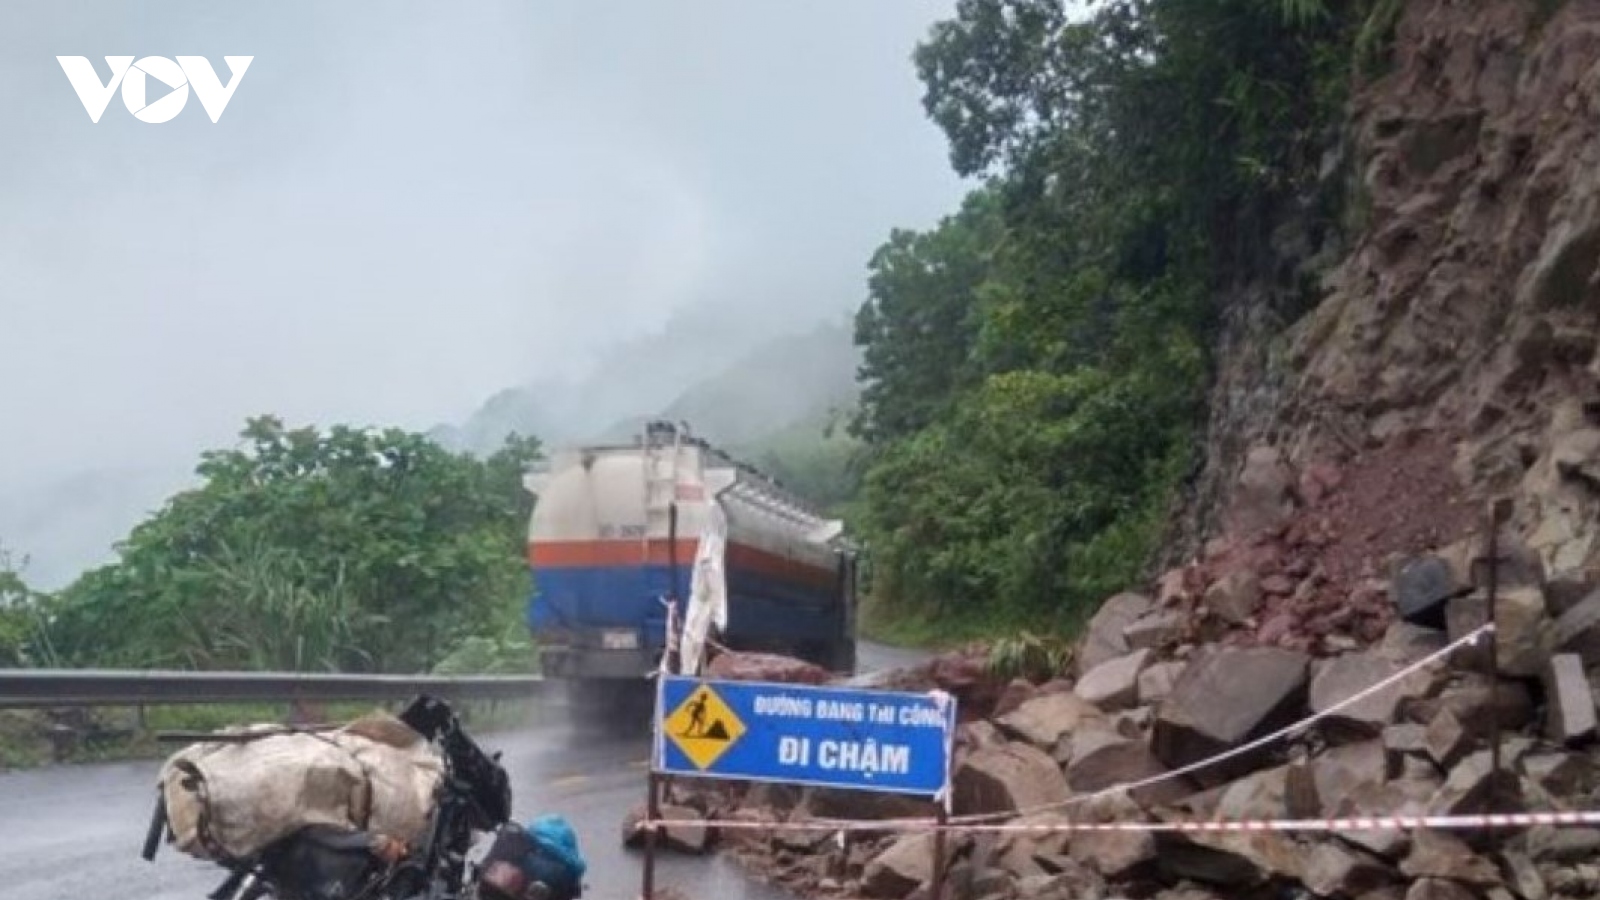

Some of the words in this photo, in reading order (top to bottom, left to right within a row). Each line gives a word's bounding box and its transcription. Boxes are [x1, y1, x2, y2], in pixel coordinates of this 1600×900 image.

[868, 703, 895, 724] THI
[779, 737, 810, 766] ĐI
[818, 738, 909, 777] CHẬM
